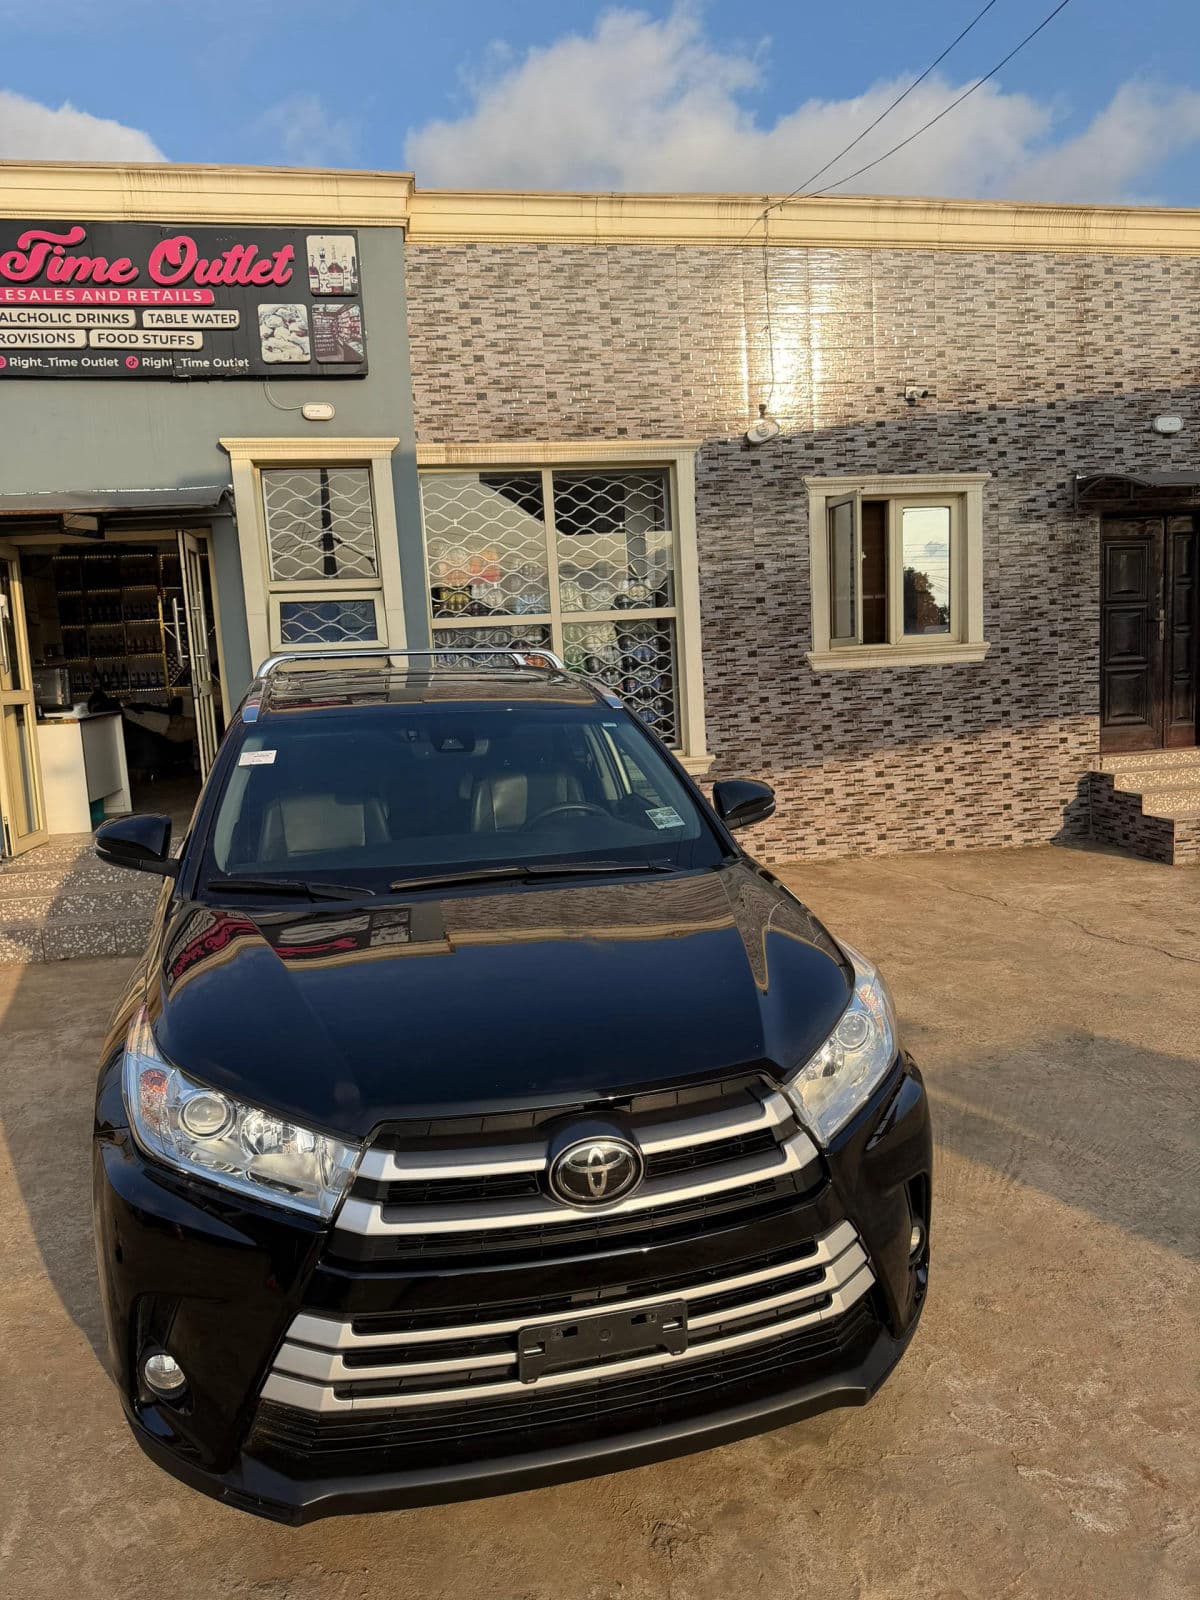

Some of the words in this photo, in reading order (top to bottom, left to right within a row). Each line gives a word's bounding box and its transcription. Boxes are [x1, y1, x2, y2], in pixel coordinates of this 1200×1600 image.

[0, 225, 140, 285] Time
[147, 235, 295, 286] Outlet
[0, 289, 76, 301] ESALES
[81, 290, 121, 302] AND
[127, 290, 203, 302] RETAILS
[0, 312, 72, 323] ALCHOLIC
[76, 313, 130, 324] DRINKS
[147, 313, 189, 324] TABLE
[191, 313, 237, 324] WATER
[97, 333, 139, 344] FOOD
[142, 333, 195, 346] STUFFS
[9, 357, 79, 369] Right_Time
[81, 357, 120, 367] Outlet
